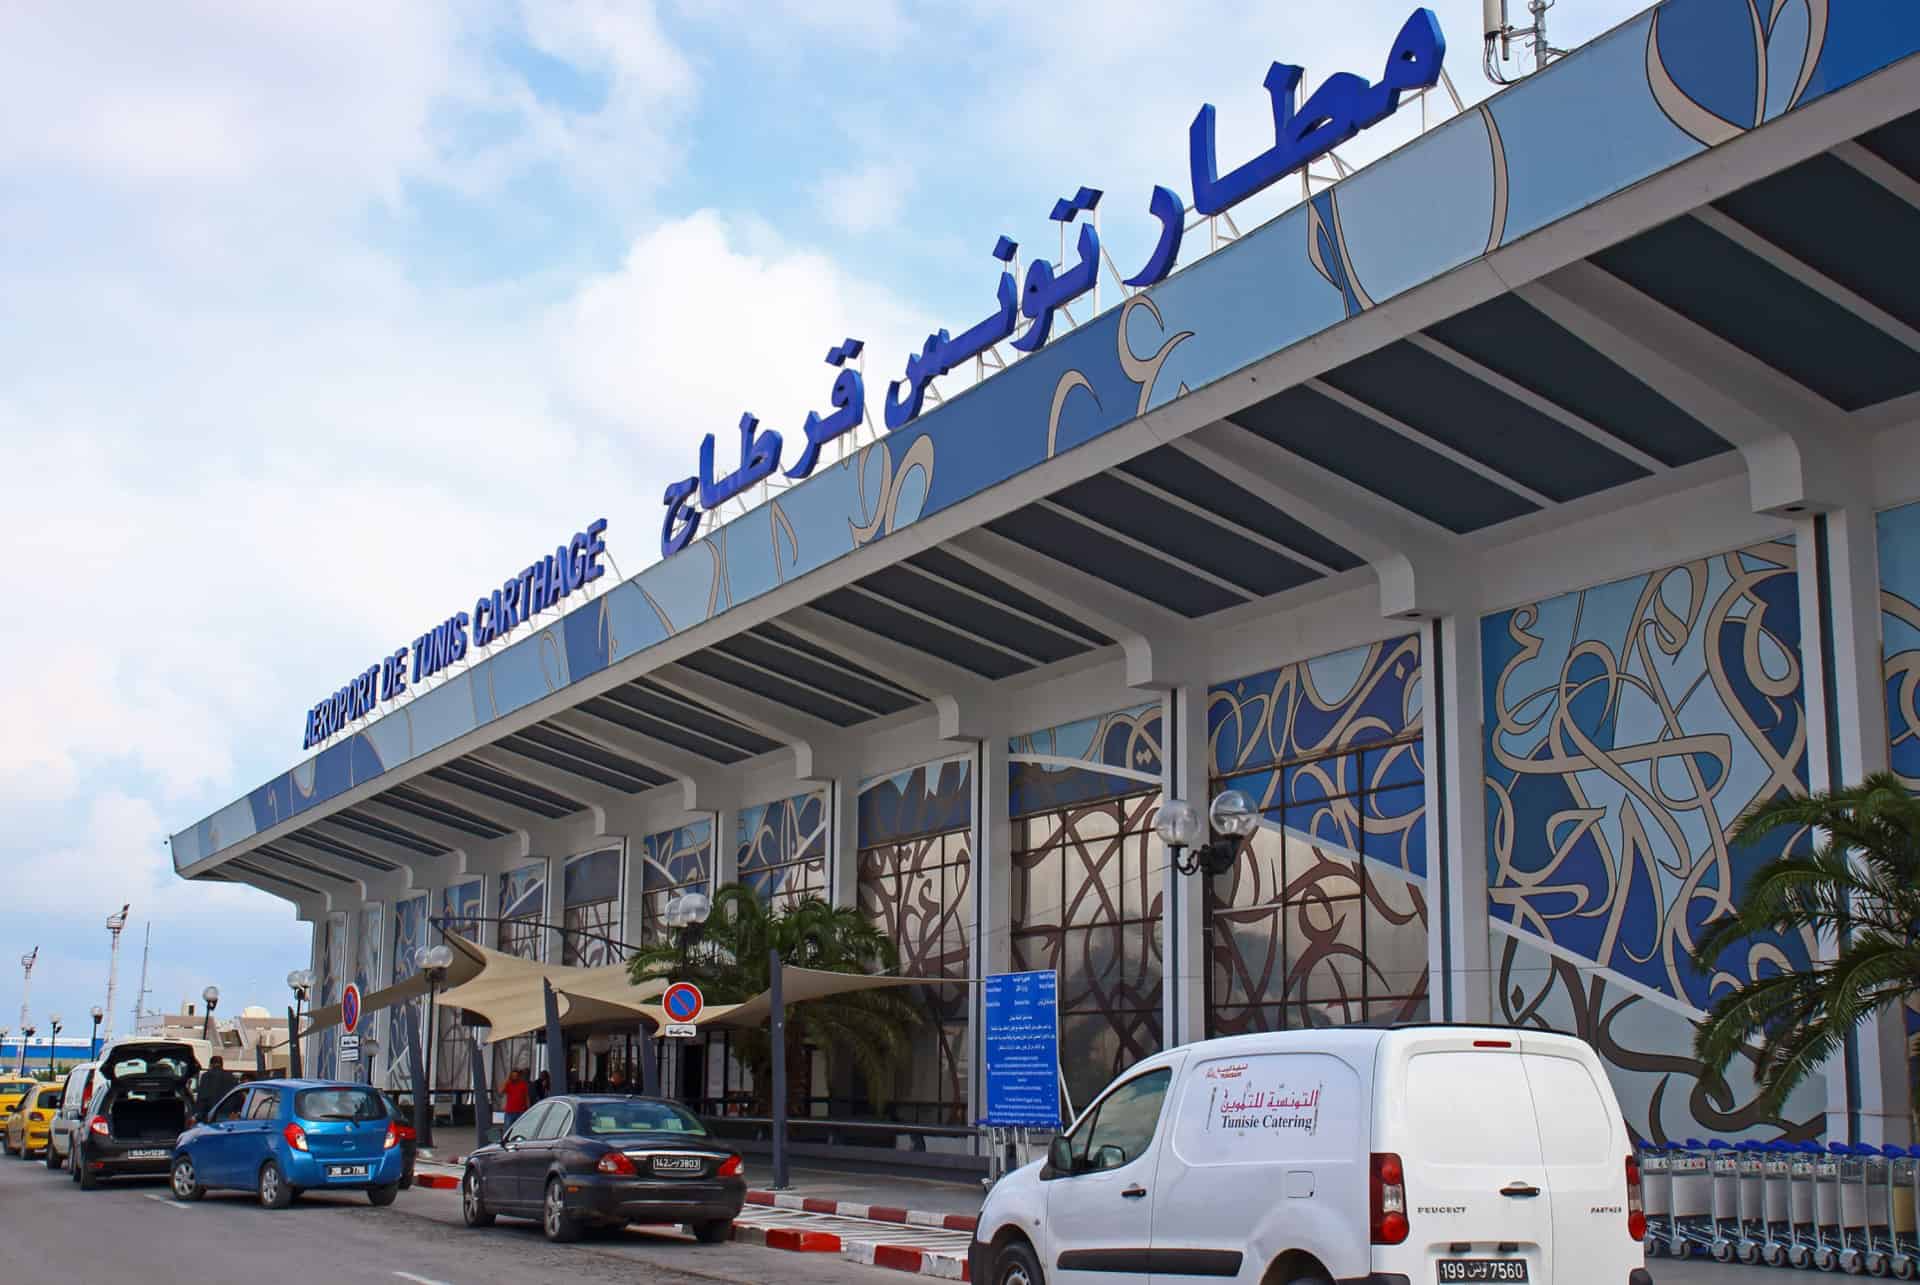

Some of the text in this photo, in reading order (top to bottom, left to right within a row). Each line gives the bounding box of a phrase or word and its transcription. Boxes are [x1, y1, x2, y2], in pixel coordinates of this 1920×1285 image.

[661, 7, 1446, 558] مطار تونس قرطاج
[303, 518, 608, 750] AEROPORT DE TUNIS CARTHAGE
[1222, 1114, 1313, 1131] Tunisie Catering
[1442, 1263, 1465, 1280] 199
[1490, 1263, 1523, 1280] 7560
